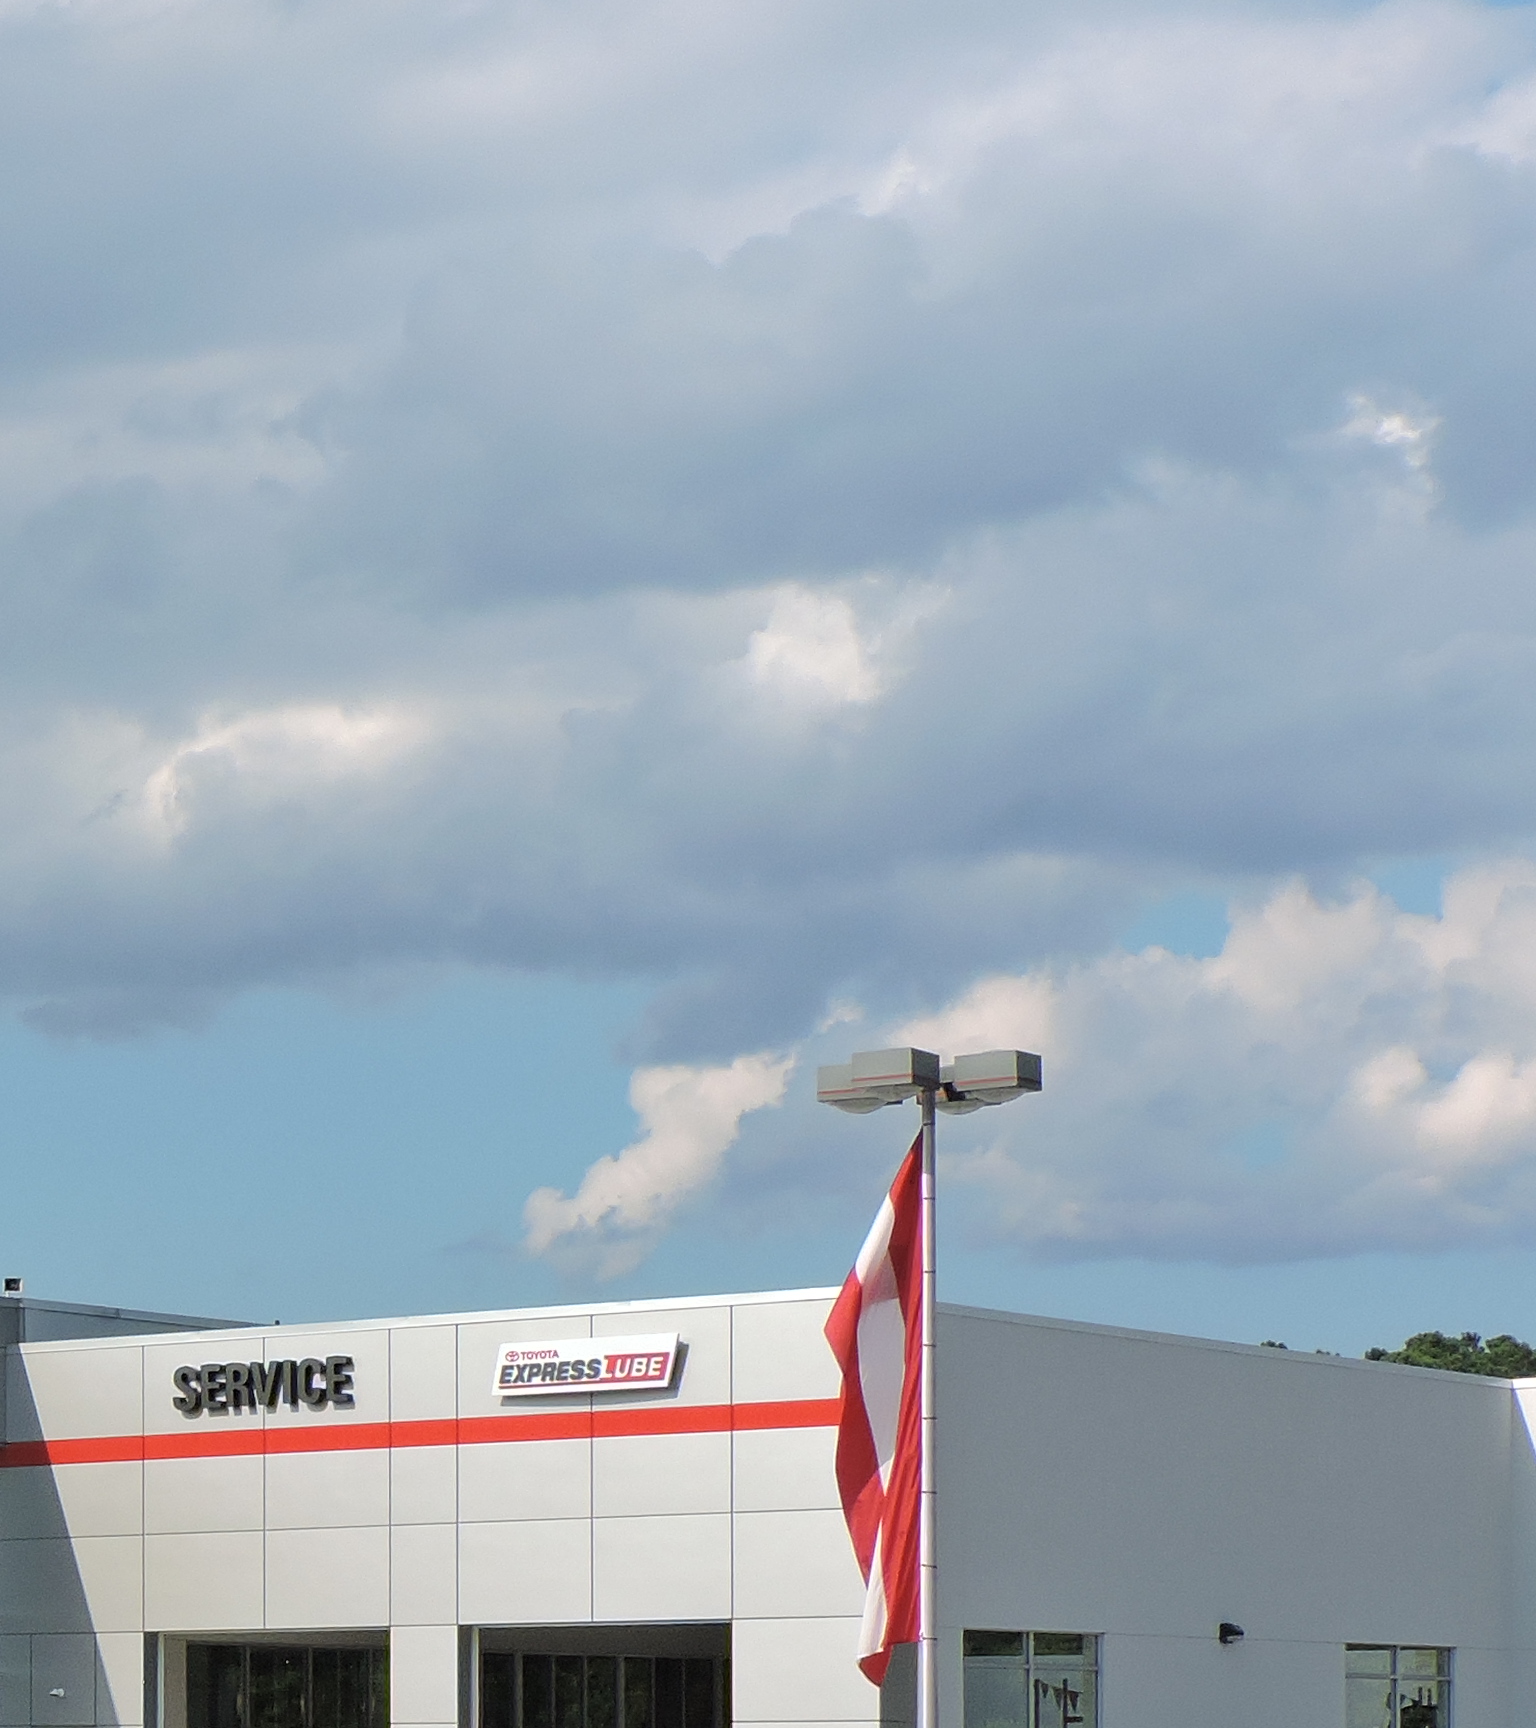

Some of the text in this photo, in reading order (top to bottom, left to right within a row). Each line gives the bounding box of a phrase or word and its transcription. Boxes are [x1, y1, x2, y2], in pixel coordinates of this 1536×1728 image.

[521, 1350, 559, 1361] TOYOTA
[499, 1356, 664, 1384] EXPRESS LUBE
[173, 1356, 355, 1413] SERVICE
